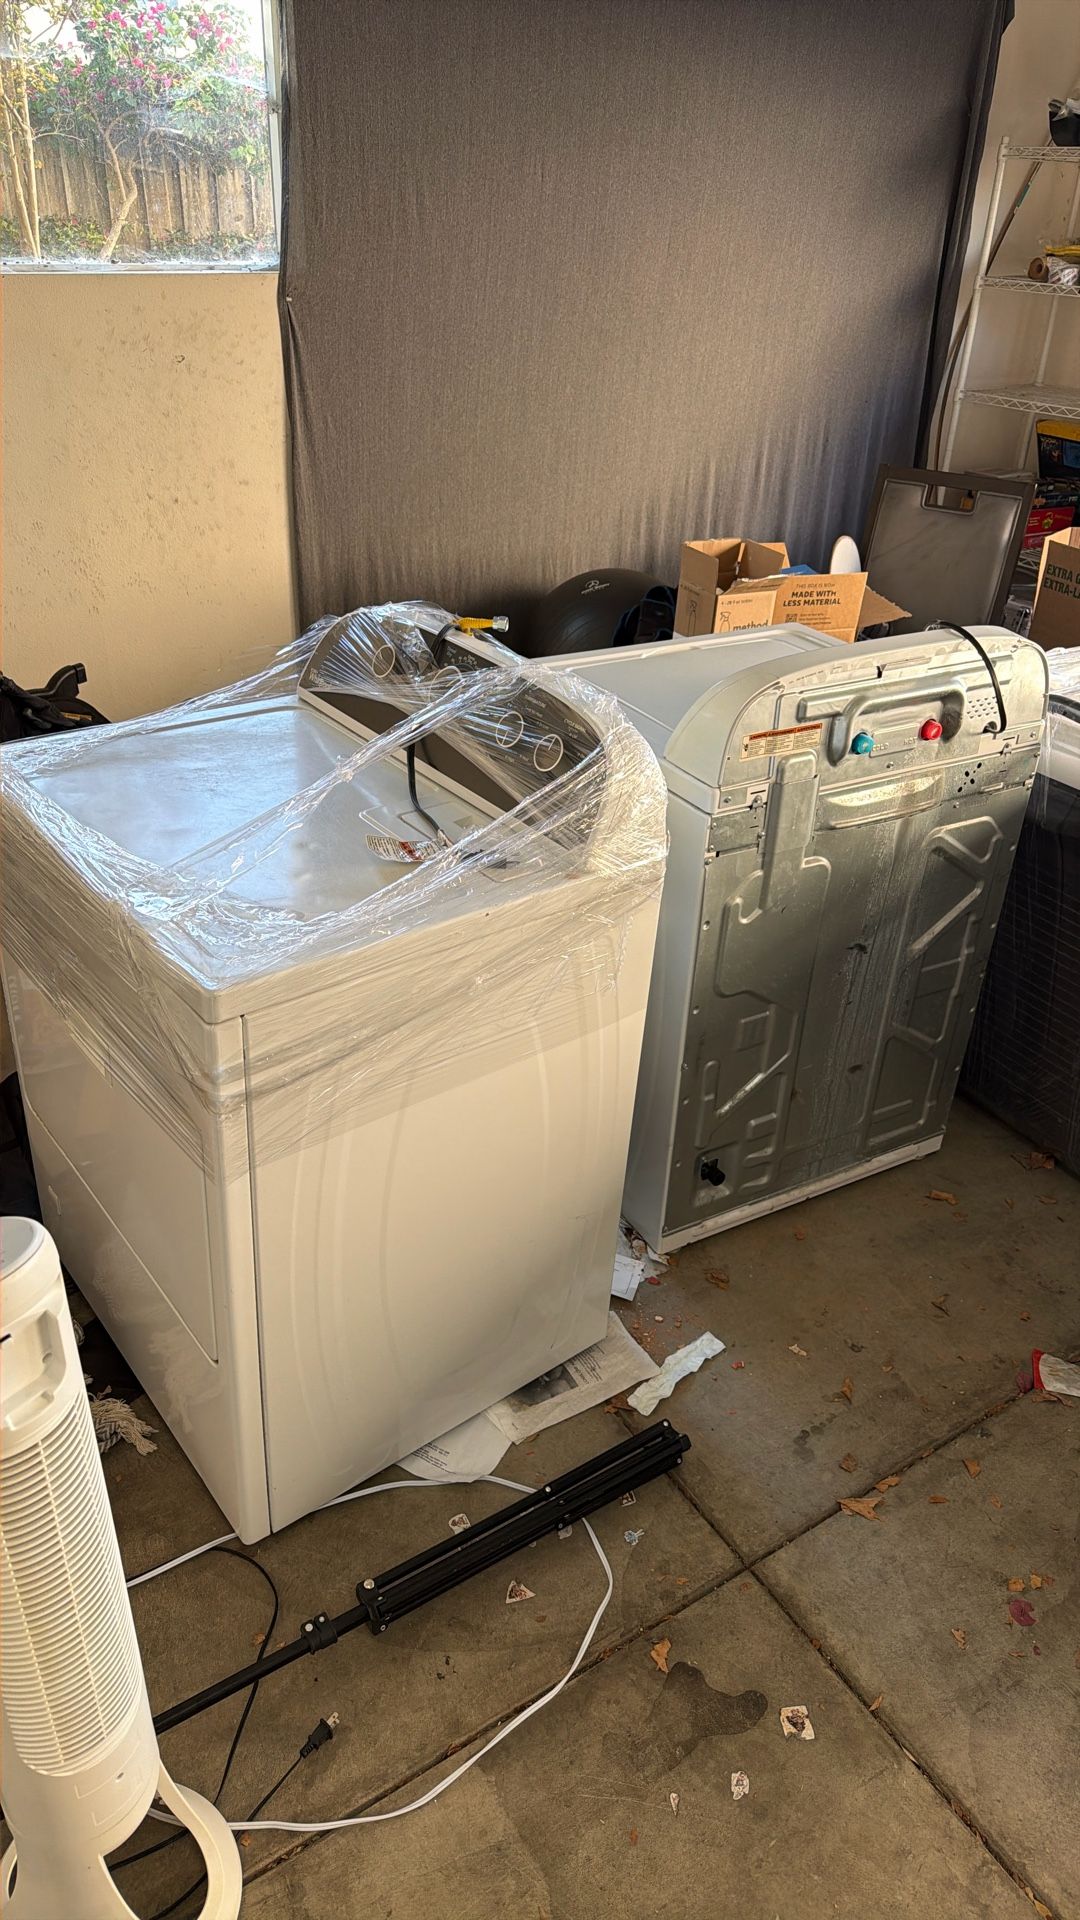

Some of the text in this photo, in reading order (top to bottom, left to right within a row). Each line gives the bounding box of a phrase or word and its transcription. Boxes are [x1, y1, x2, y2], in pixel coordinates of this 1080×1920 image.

[1047, 564, 1073, 582] EXTRA
[1044, 577, 1080, 599] EXTRA-L
[791, 590, 815, 598] MADE
[783, 597, 841, 607] LESS MATERIAL
[733, 620, 769, 631] method
